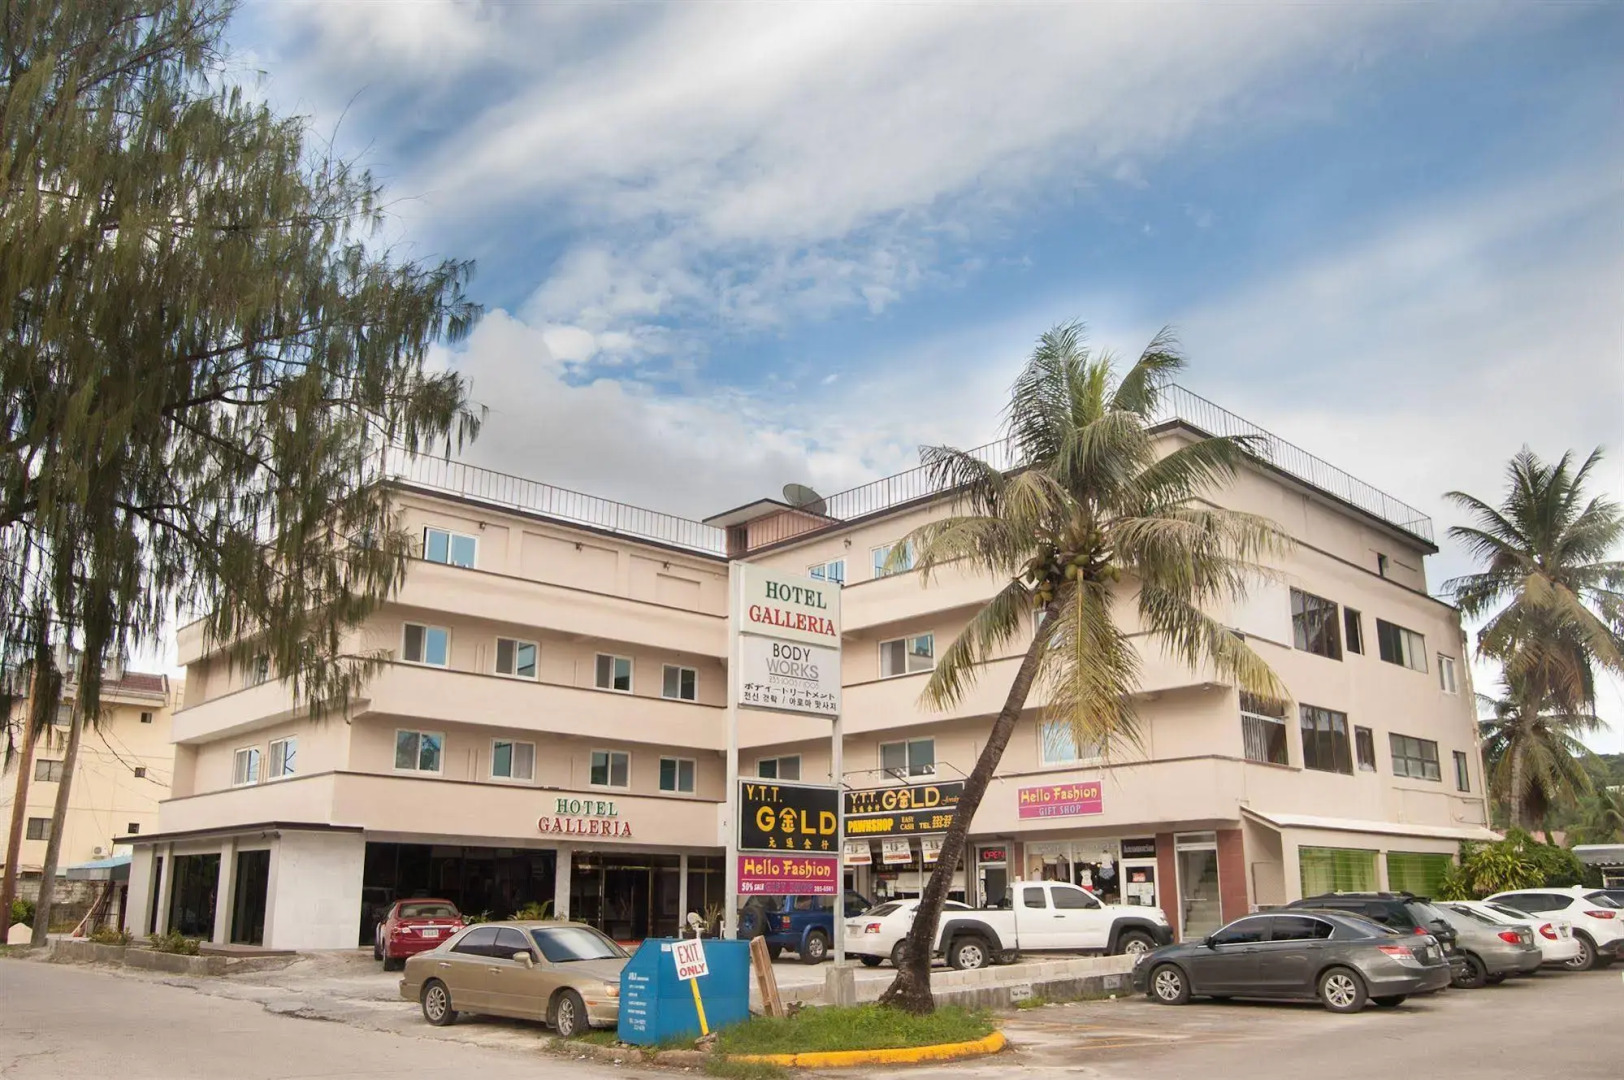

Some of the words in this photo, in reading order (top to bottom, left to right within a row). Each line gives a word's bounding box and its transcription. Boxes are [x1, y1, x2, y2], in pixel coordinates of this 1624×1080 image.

[765, 580, 827, 609] HOTEL
[749, 604, 837, 636] GALLERIA
[773, 643, 811, 662] BODY
[766, 657, 819, 679] WORKS
[746, 784, 783, 803] Y.T.T.
[850, 791, 878, 804] Y.T.T.
[1021, 788, 1051, 804] Hello
[1053, 785, 1098, 801] Fashion
[556, 798, 618, 816] HOTEL
[1039, 806, 1056, 816] GIFT
[1060, 804, 1081, 815] SHOP
[538, 816, 632, 836] GALLERIA
[847, 817, 894, 833] PAWNSHOP
[744, 858, 780, 875] Hello
[782, 859, 831, 878] Fashion
[677, 942, 699, 964] EXIT
[679, 963, 705, 977] ONLY
